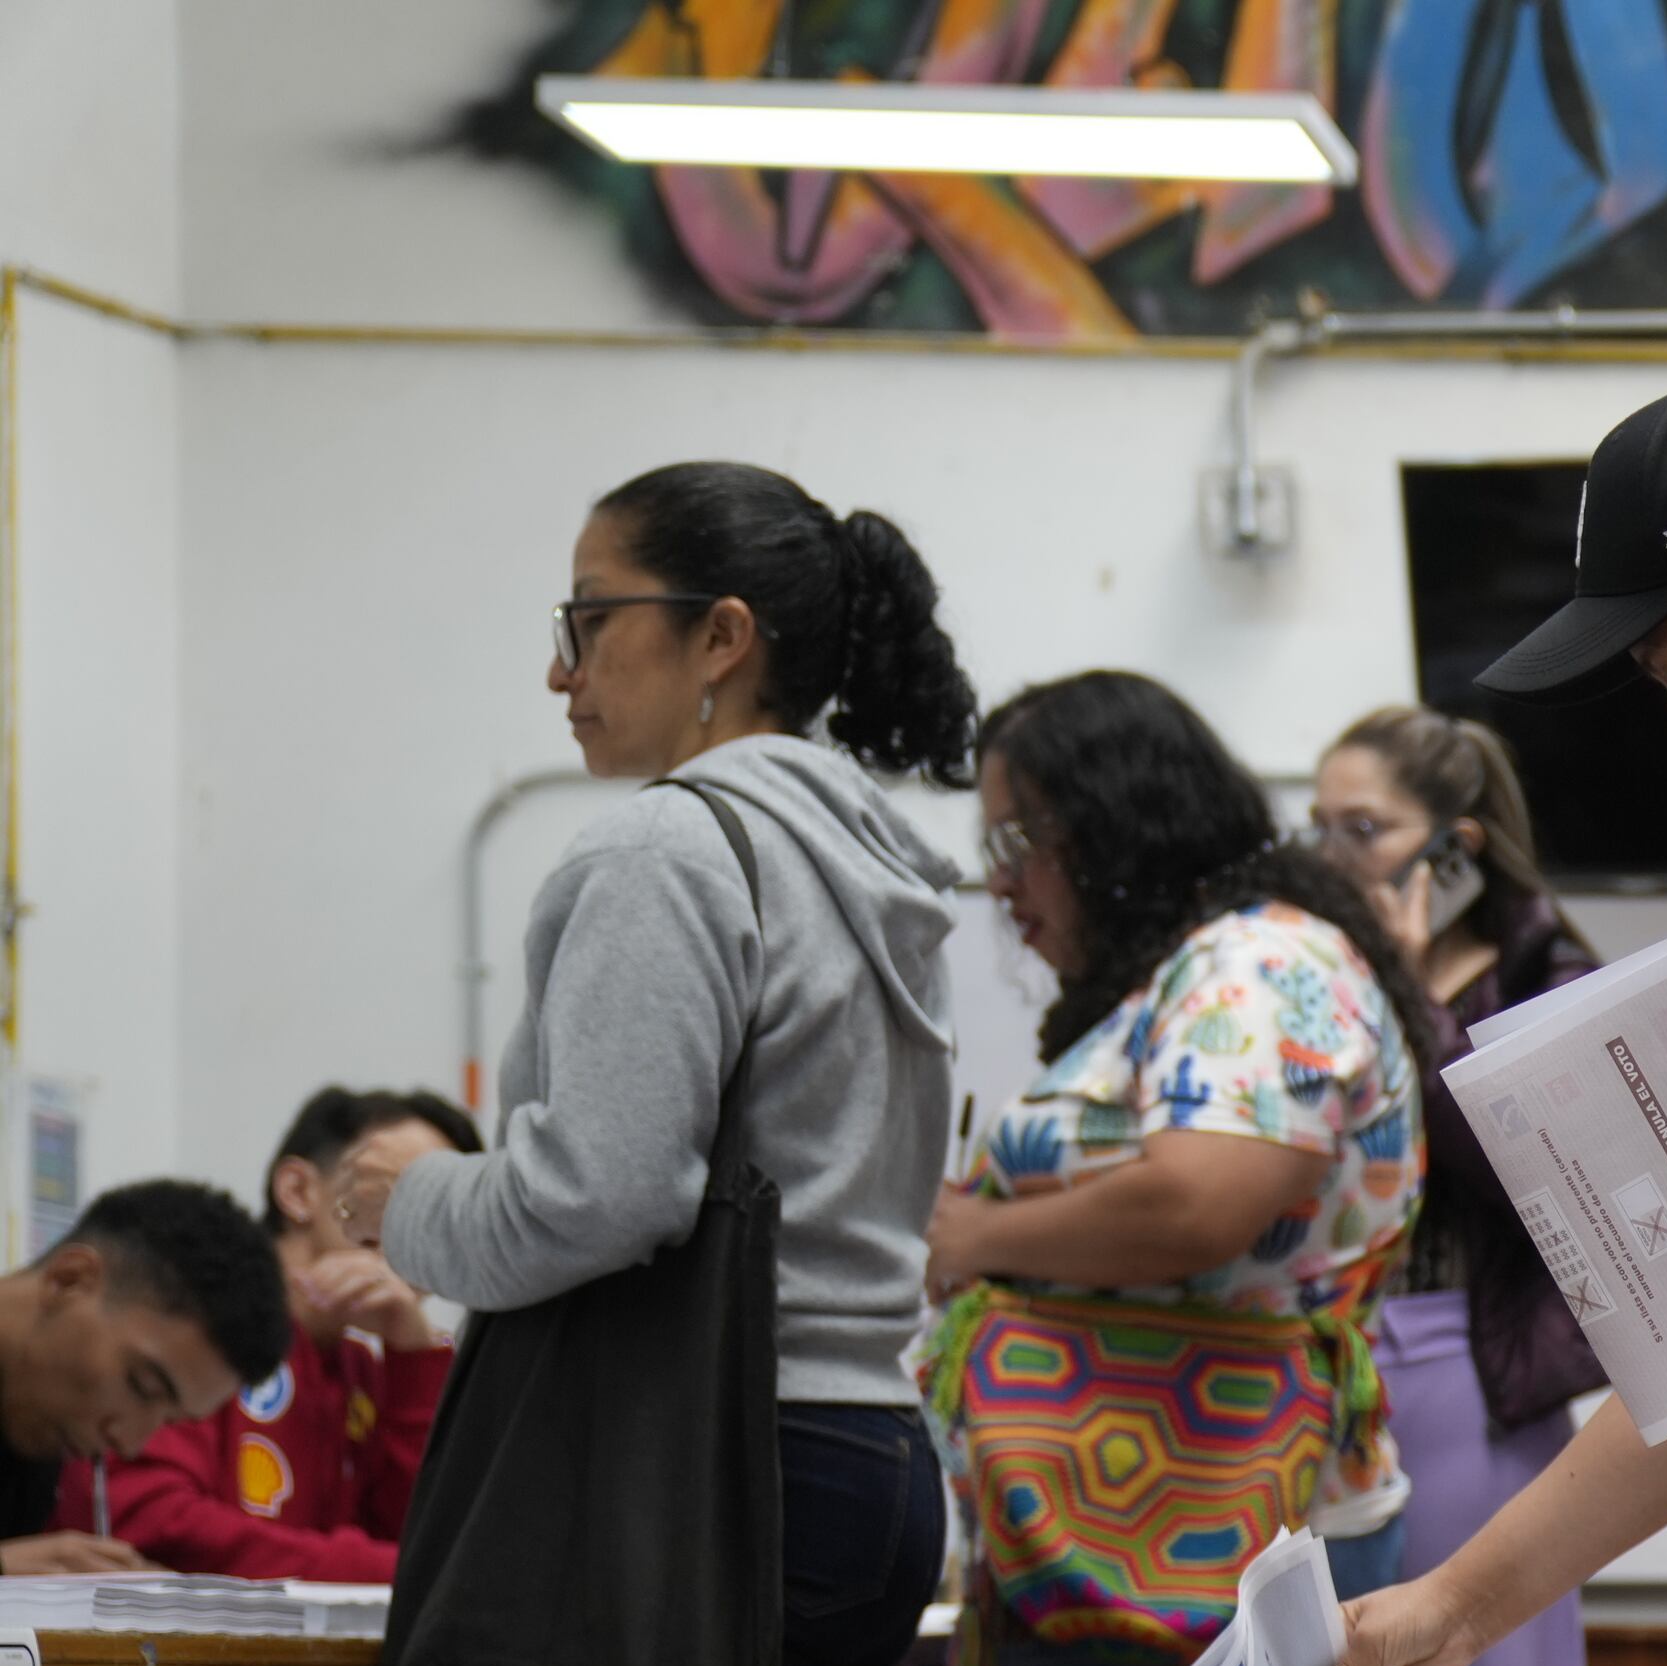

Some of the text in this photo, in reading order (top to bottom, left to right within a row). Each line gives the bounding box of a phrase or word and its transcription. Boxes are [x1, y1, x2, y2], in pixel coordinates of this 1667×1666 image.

[1611, 1043, 1640, 1082] VOTO
[1633, 1081, 1651, 1101] EL
[1535, 1126, 1569, 1174] (cerrada)
[1569, 1158, 1588, 1182] lista
[1582, 1181, 1594, 1194] la
[1562, 1172, 1599, 1226] preferente
[1589, 1193, 1602, 1208] de
[1593, 1224, 1605, 1239] no
[1597, 1206, 1628, 1252] recuadro
[1600, 1239, 1618, 1262] voto
[1622, 1251, 1634, 1263] el
[1614, 1261, 1629, 1281] con
[1629, 1261, 1657, 1300] marque
[1626, 1281, 1637, 1294] es
[1631, 1294, 1650, 1318] lista
[1646, 1317, 1657, 1330] su
